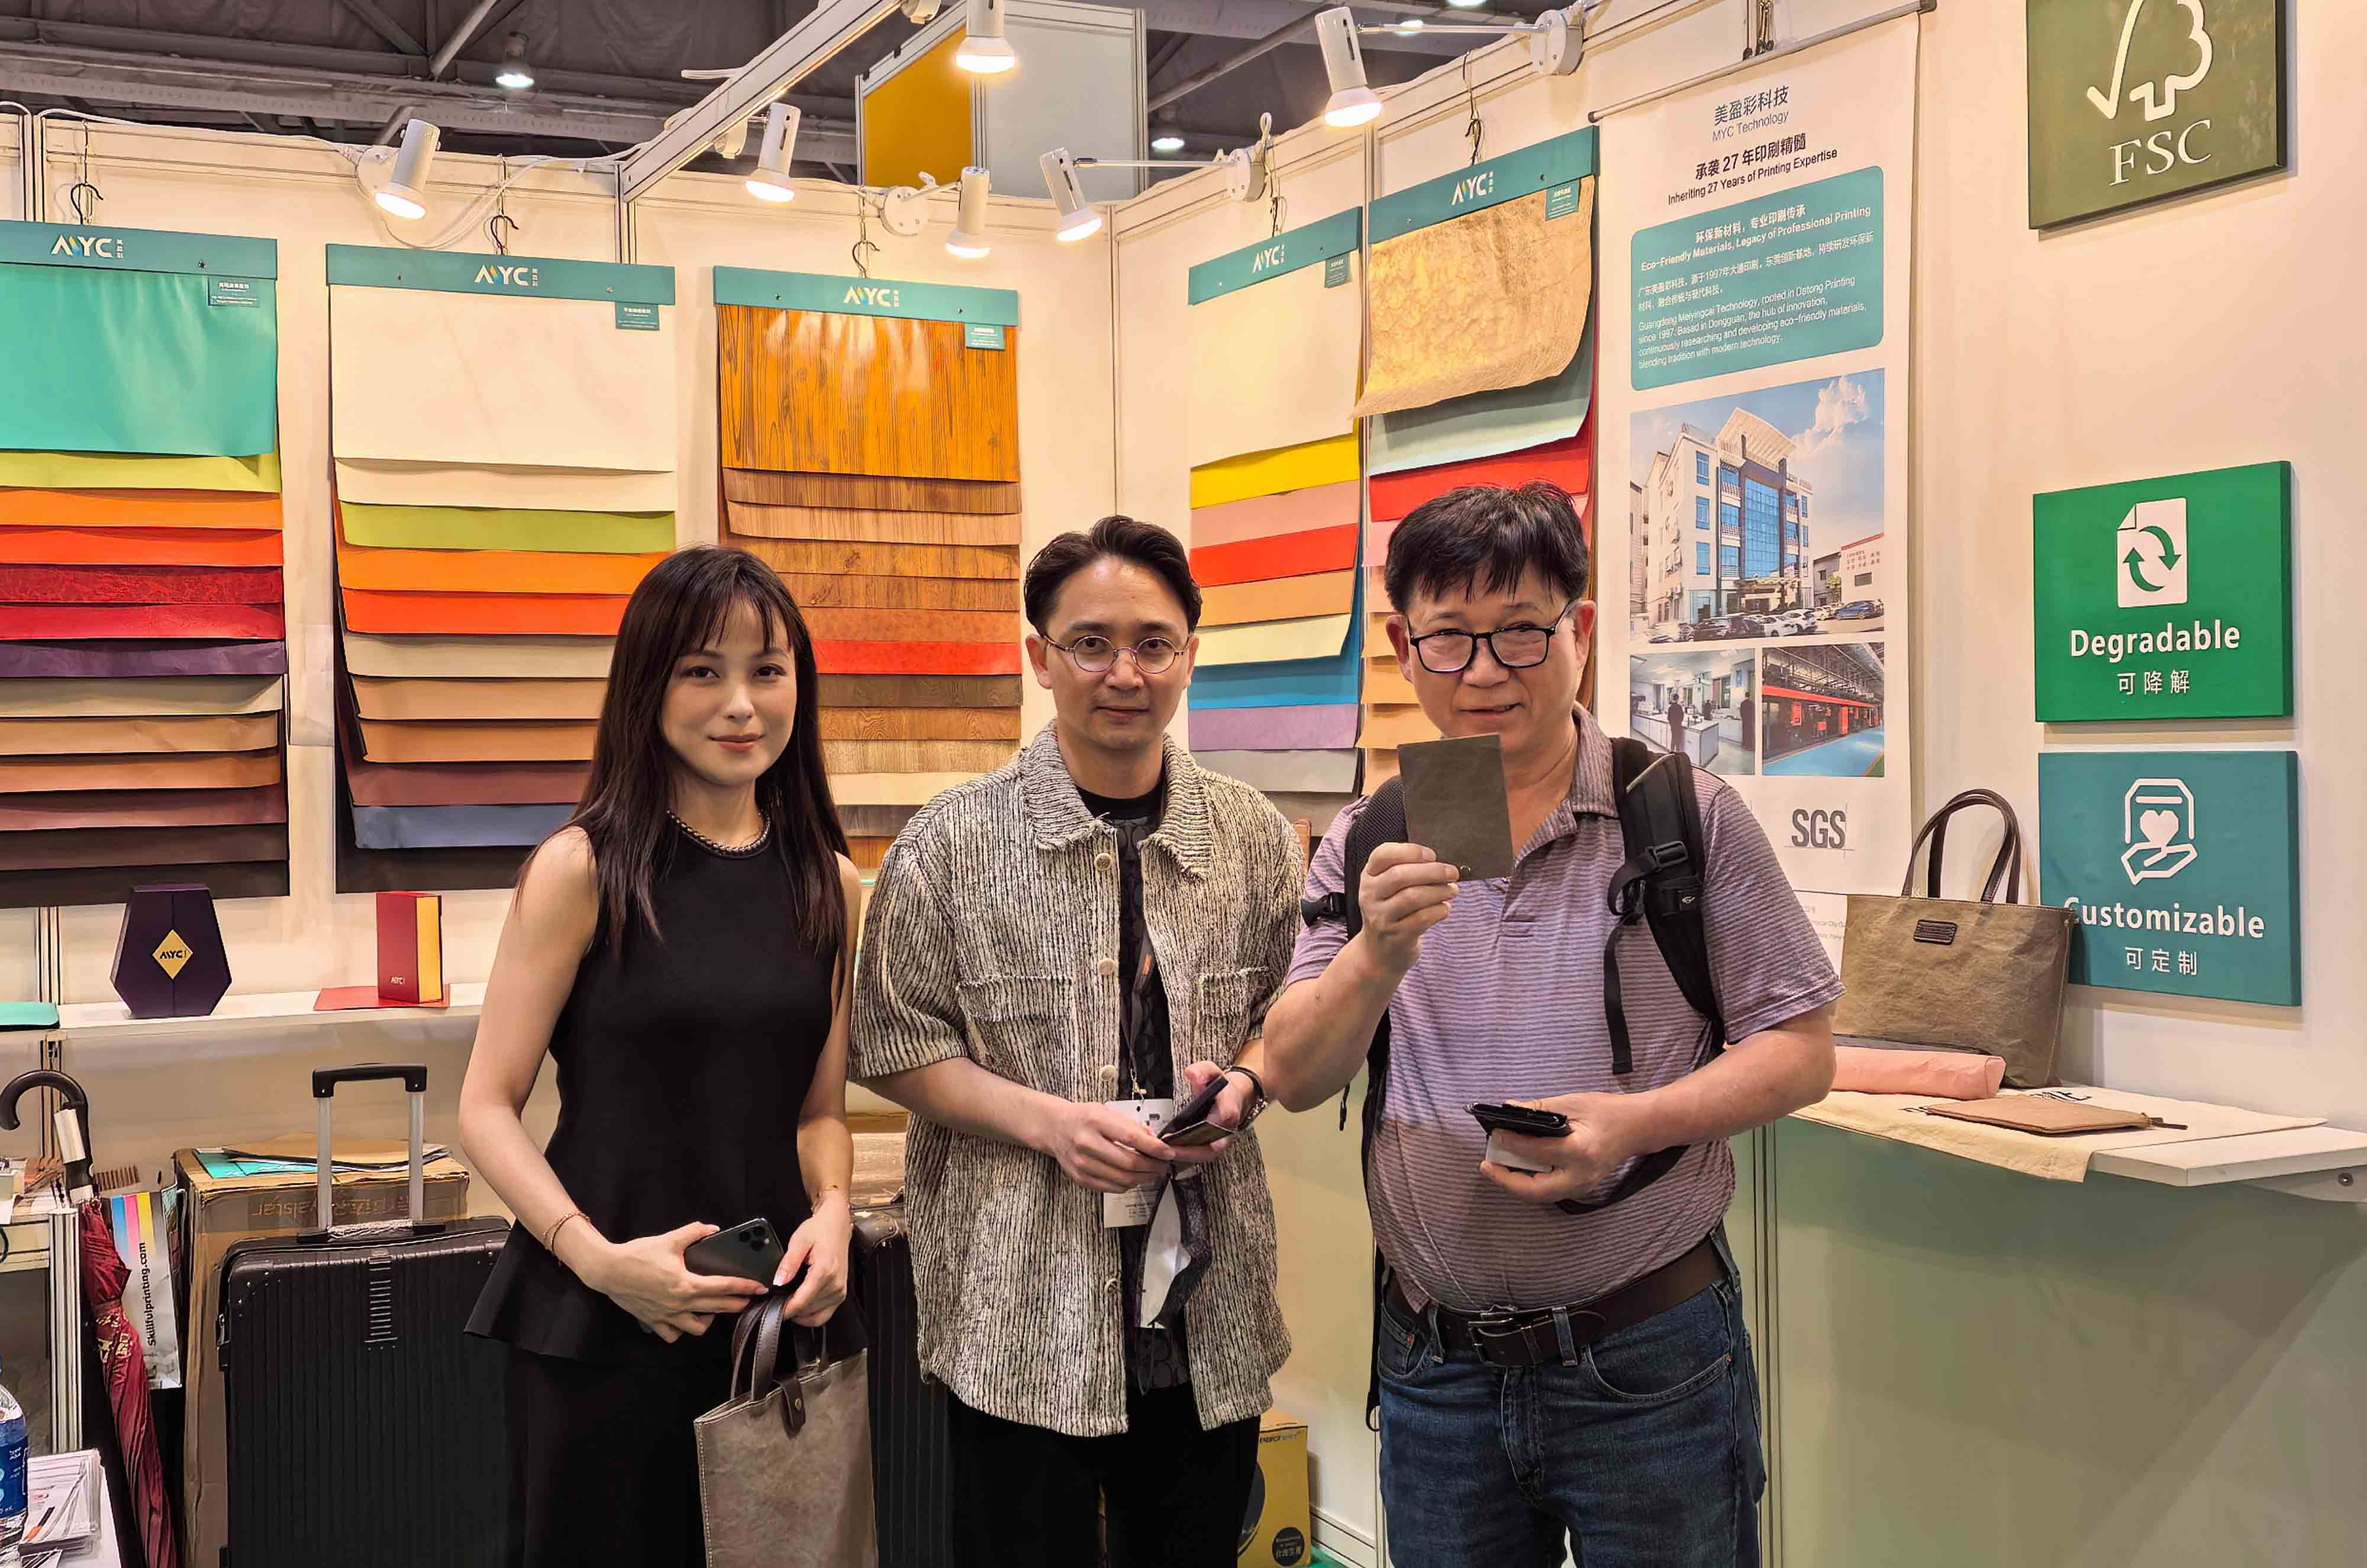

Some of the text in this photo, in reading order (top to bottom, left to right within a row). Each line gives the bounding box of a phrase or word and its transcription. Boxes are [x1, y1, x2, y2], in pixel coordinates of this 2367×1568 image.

[1714, 85, 1789, 126] 美盈彩科技
[1712, 111, 1789, 143] MYC Technology
[1723, 153, 1739, 173] 27
[2108, 119, 2211, 186] FSC
[1668, 148, 1838, 205] Inheriting 27 Years of Printing Expertise
[1641, 206, 1871, 272] Eco-Friendly Materials, Legacy of Professional Printing
[1825, 276, 1856, 291] Printing
[2071, 619, 2240, 663] Degradable
[2117, 669, 2190, 696] 可降解
[1791, 808, 1846, 848] SGS
[2124, 946, 2198, 976] 可定制
